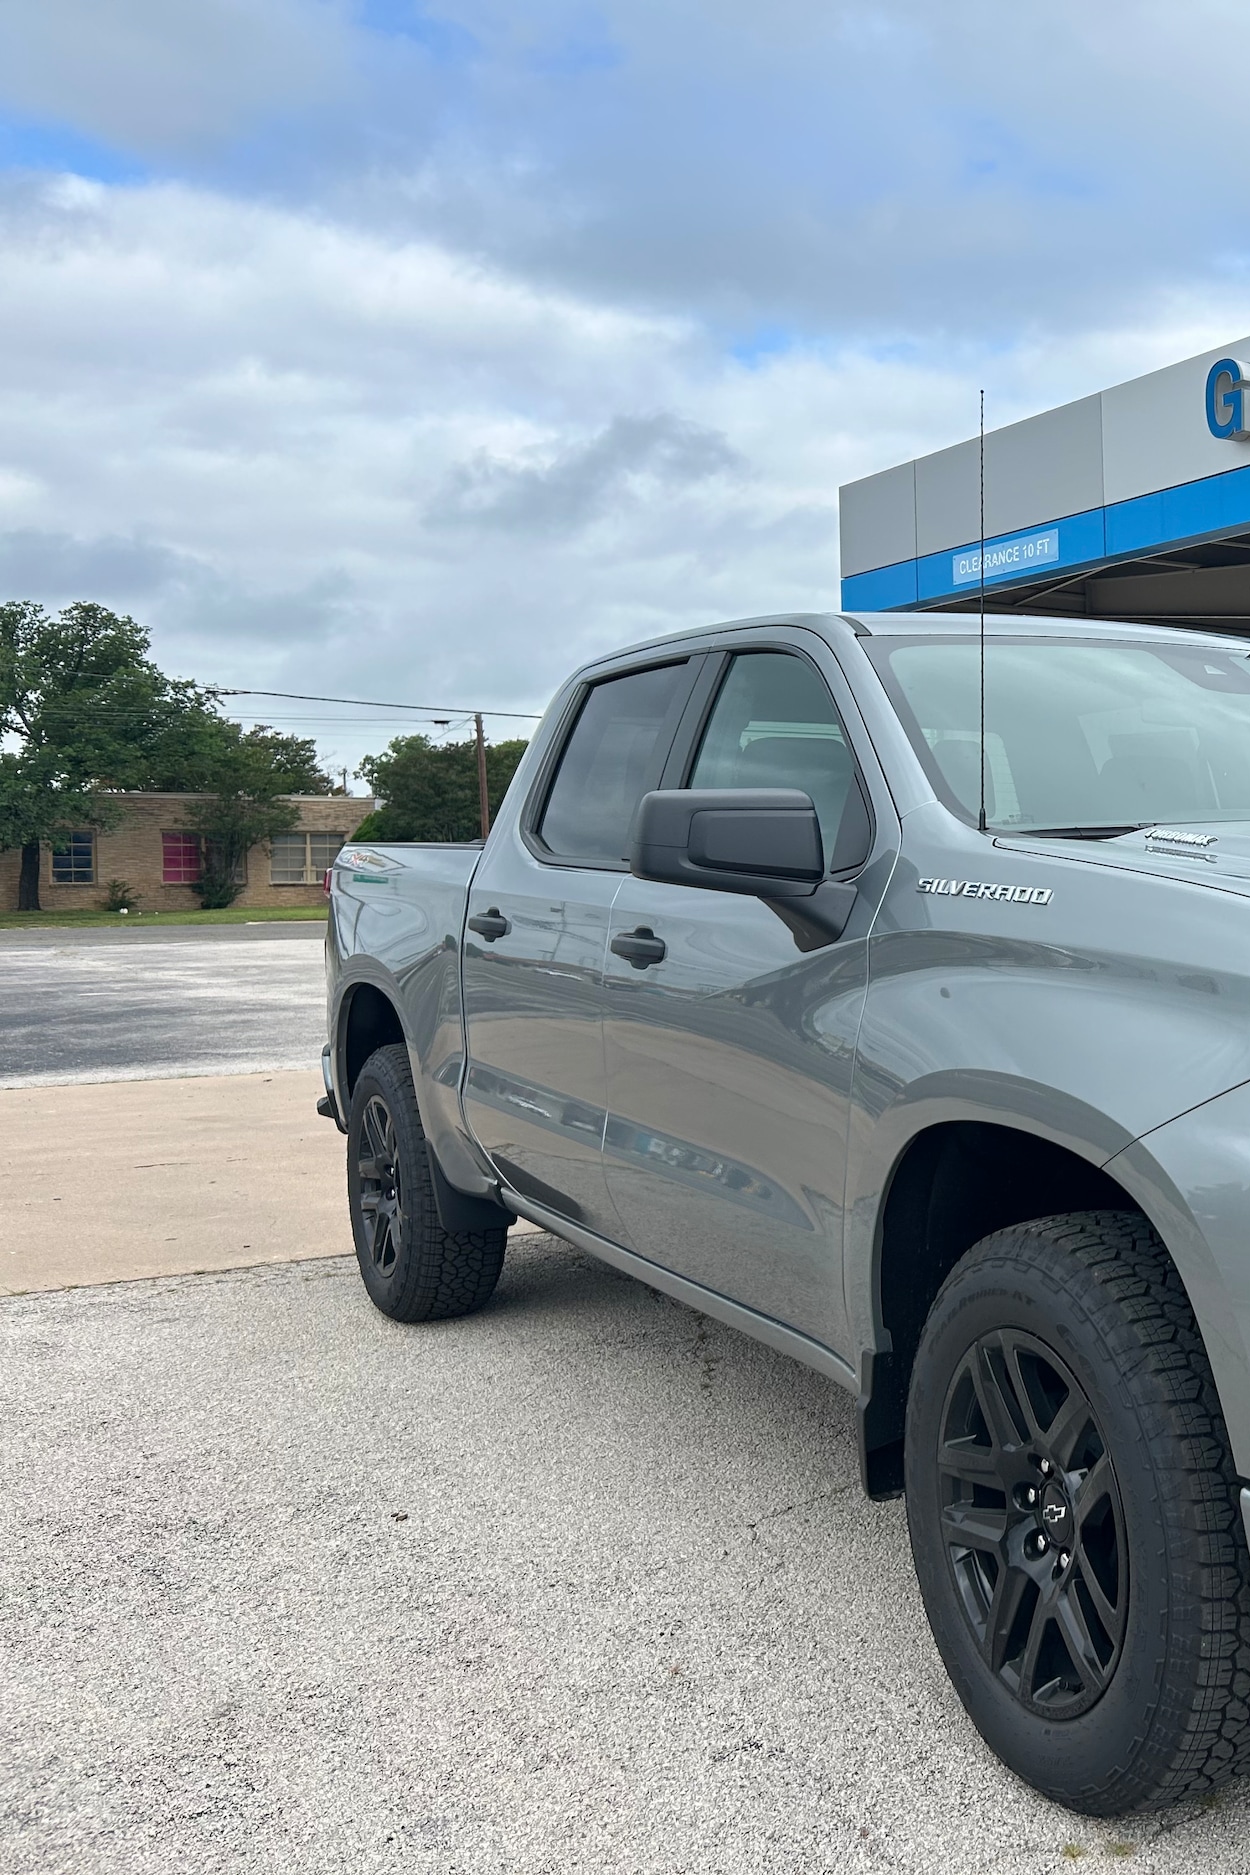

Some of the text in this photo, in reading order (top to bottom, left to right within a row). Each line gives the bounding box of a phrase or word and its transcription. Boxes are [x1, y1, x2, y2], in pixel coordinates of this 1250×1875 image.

[959, 538, 1050, 575] CLEARANCE 10 FT
[916, 877, 1053, 906] SILVERADO
